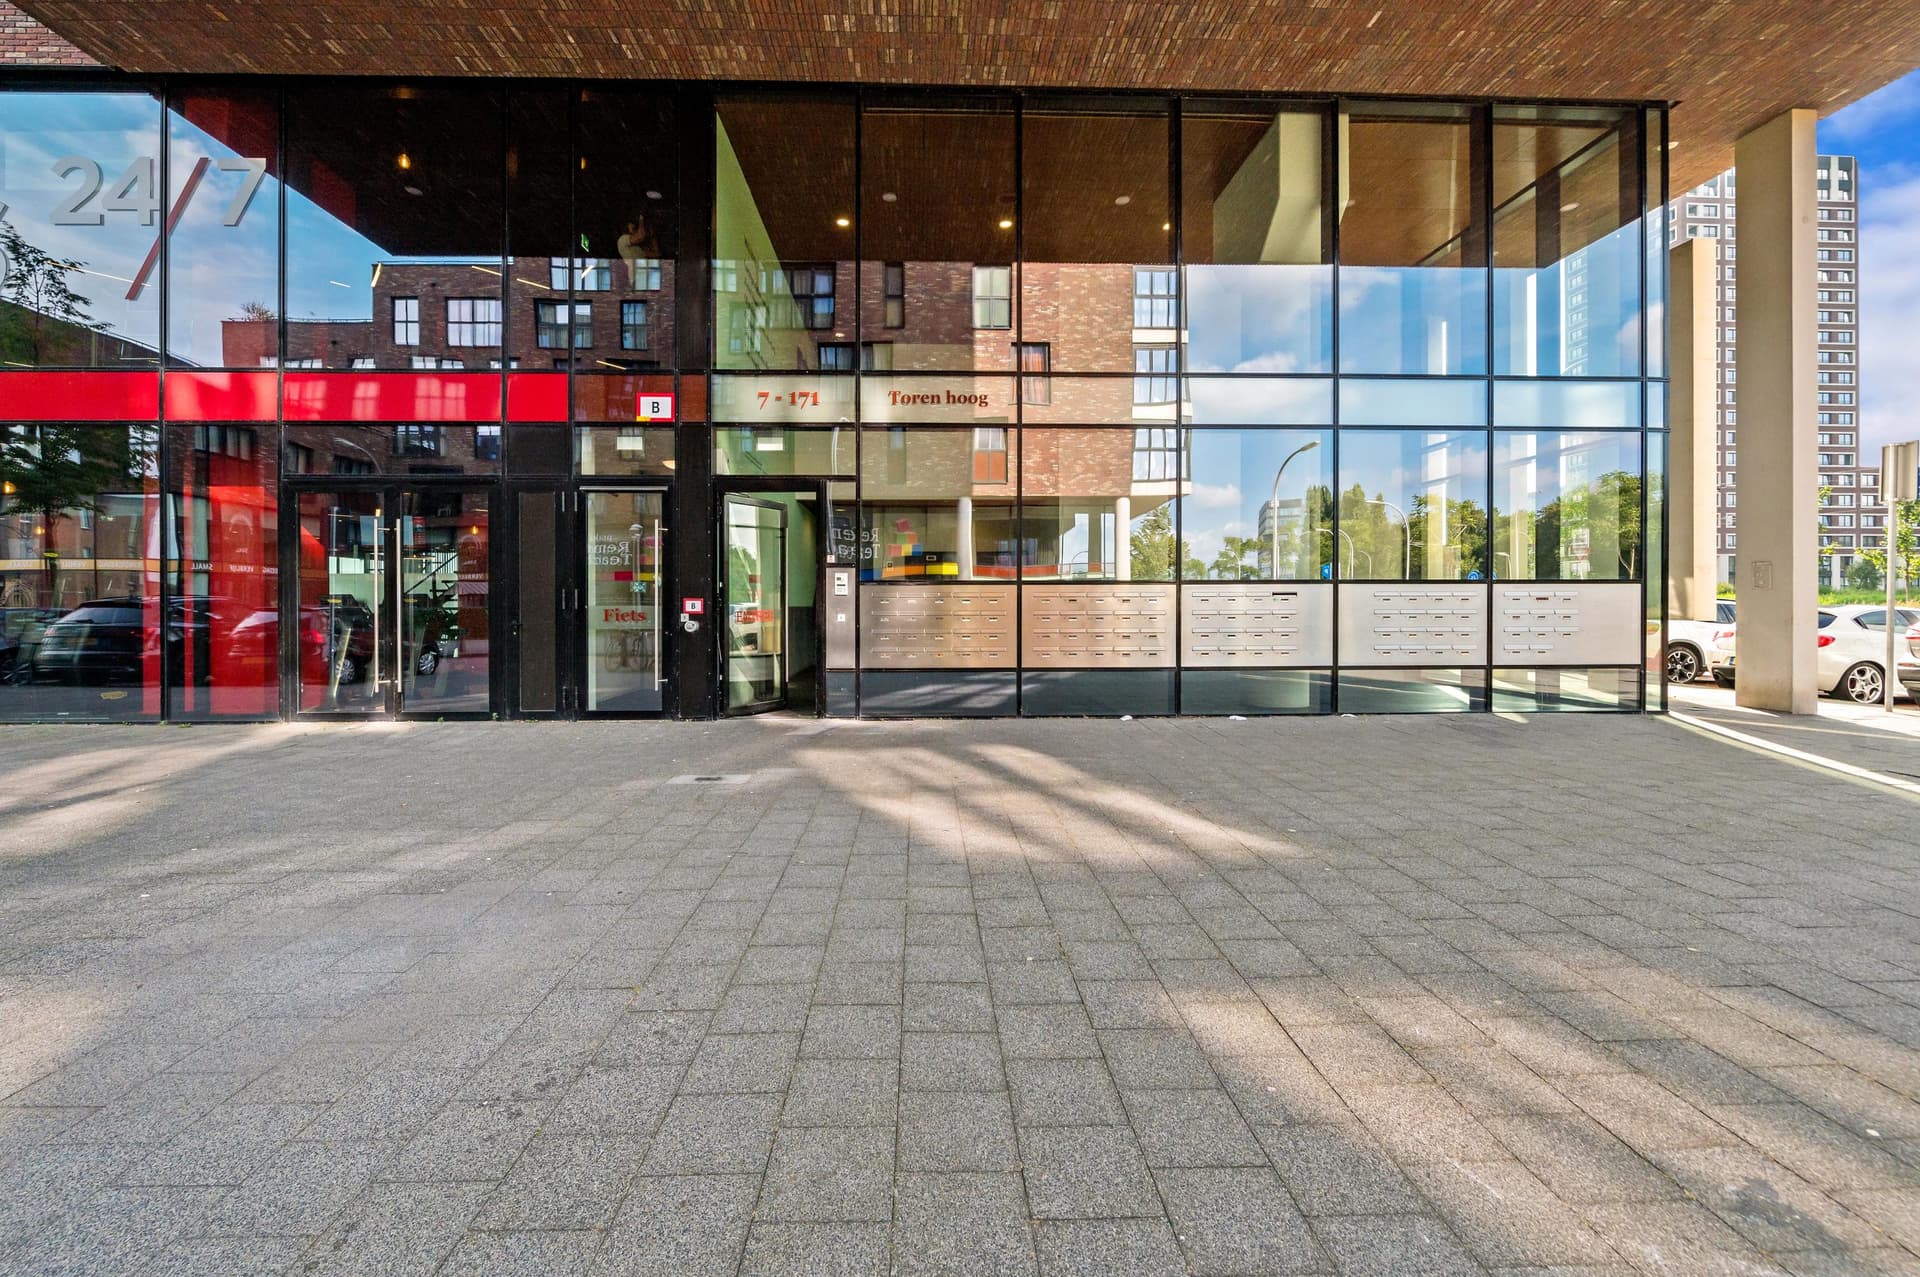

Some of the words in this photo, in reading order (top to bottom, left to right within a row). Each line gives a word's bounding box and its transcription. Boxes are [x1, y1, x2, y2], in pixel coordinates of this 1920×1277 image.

[52, 156, 267, 301] 24/7
[757, 391, 770, 410] 7
[789, 391, 820, 410] 171
[888, 390, 941, 406] Toren
[946, 389, 989, 407] hoog
[651, 401, 660, 414] B
[602, 608, 648, 622] Fiets
